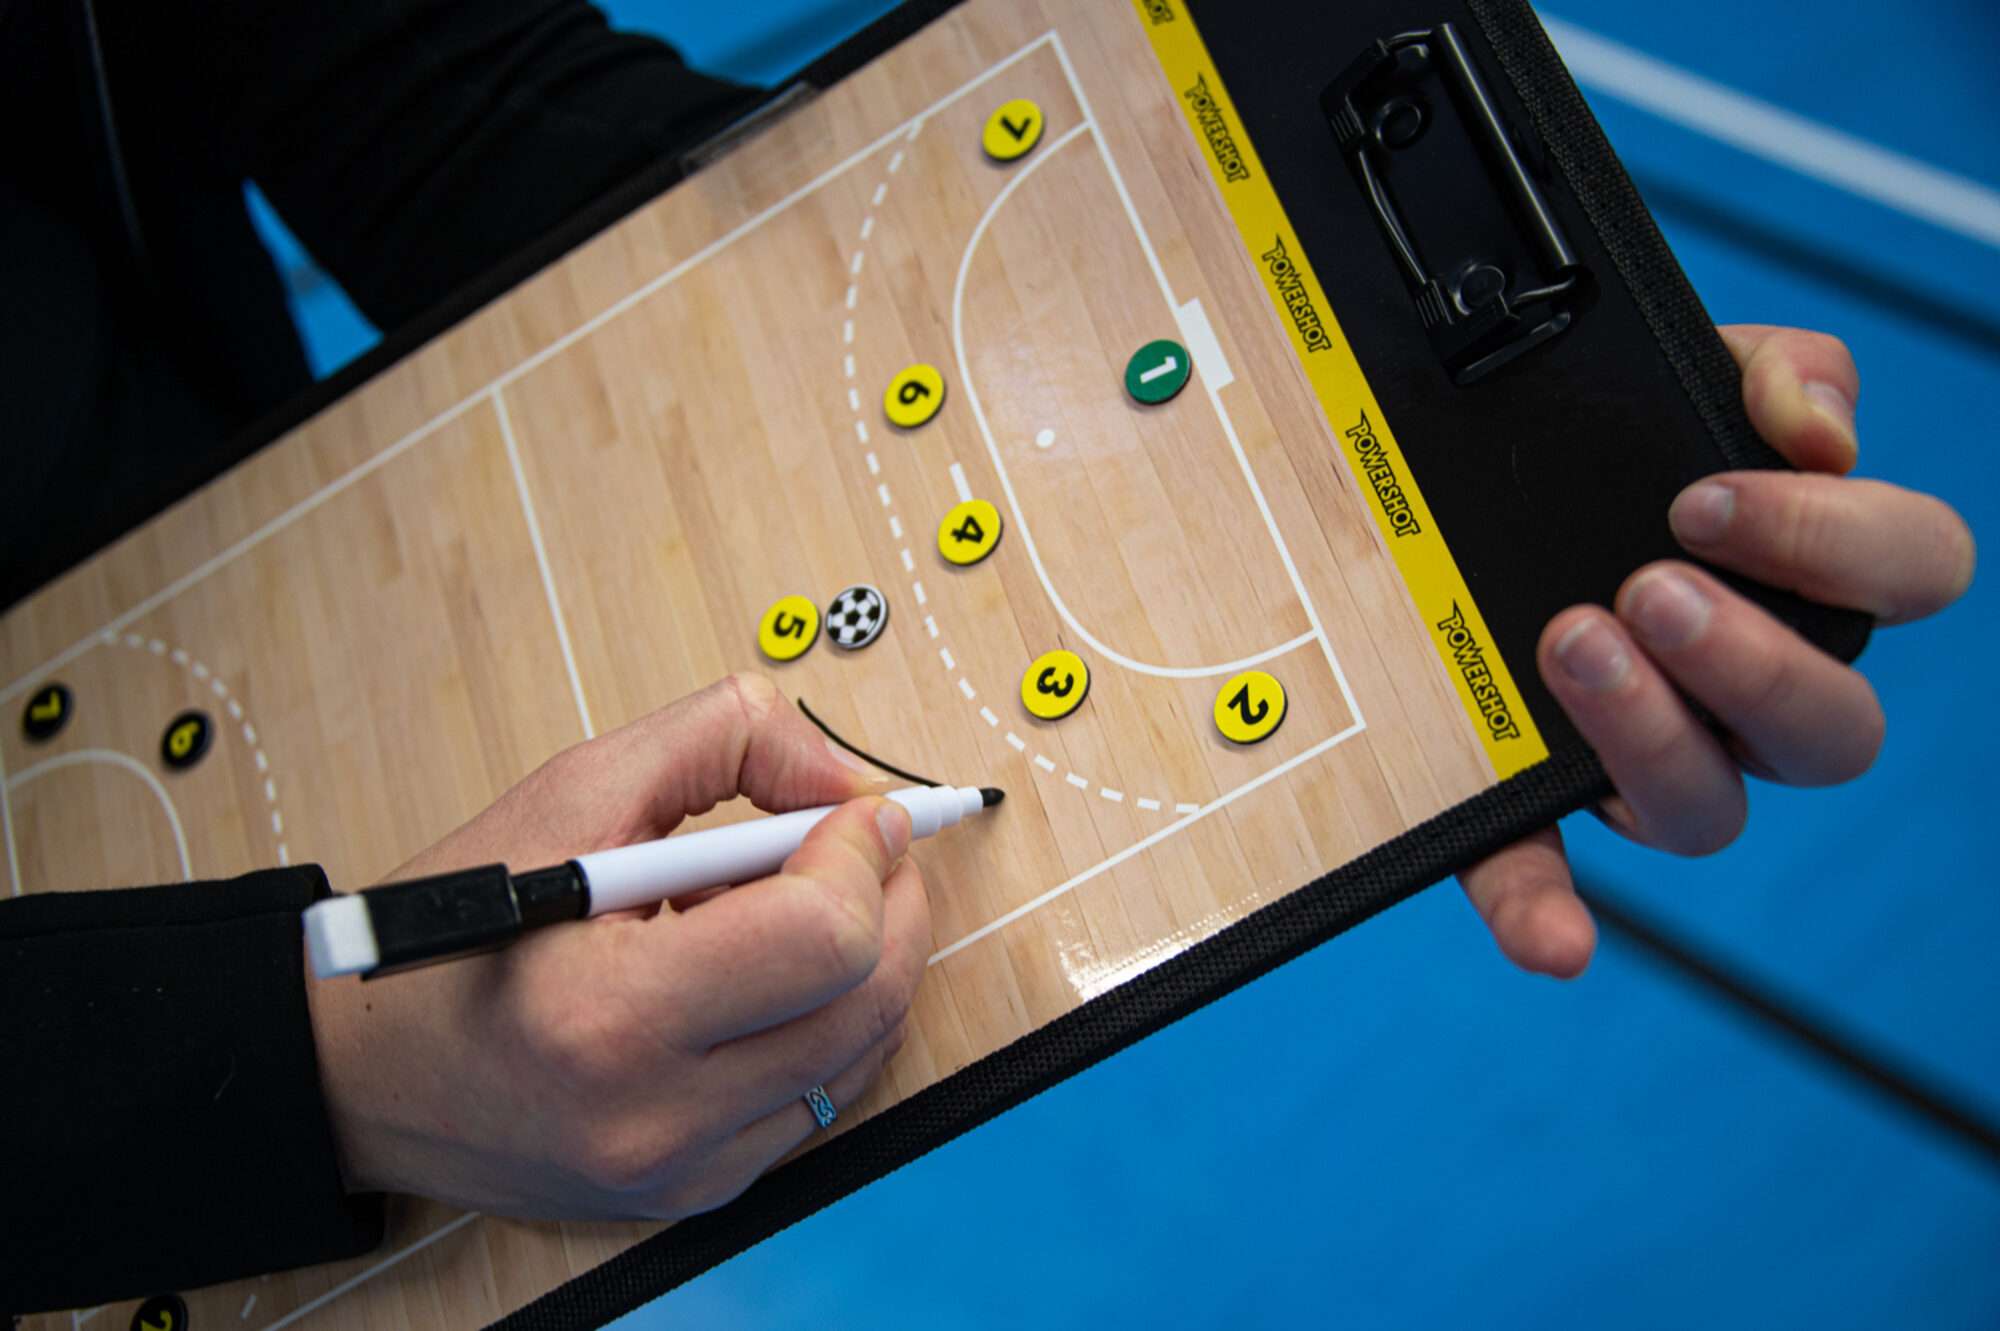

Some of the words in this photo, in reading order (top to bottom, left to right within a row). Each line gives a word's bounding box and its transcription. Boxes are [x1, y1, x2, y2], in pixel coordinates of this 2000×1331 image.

[1000, 116, 1031, 141] 7
[1183, 72, 1250, 183] POWERSHOT
[1261, 234, 1332, 353] POWERSHOT
[1140, 356, 1178, 384] 1
[899, 379, 930, 406] 6
[1345, 409, 1421, 538] POWERSHOT
[951, 515, 985, 546] 4
[773, 611, 806, 640] 5
[1035, 667, 1075, 698] 3
[1437, 598, 1520, 742] POWERSHOT
[32, 691, 60, 721] 7
[1227, 683, 1270, 725] 2
[170, 722, 199, 757] 6
